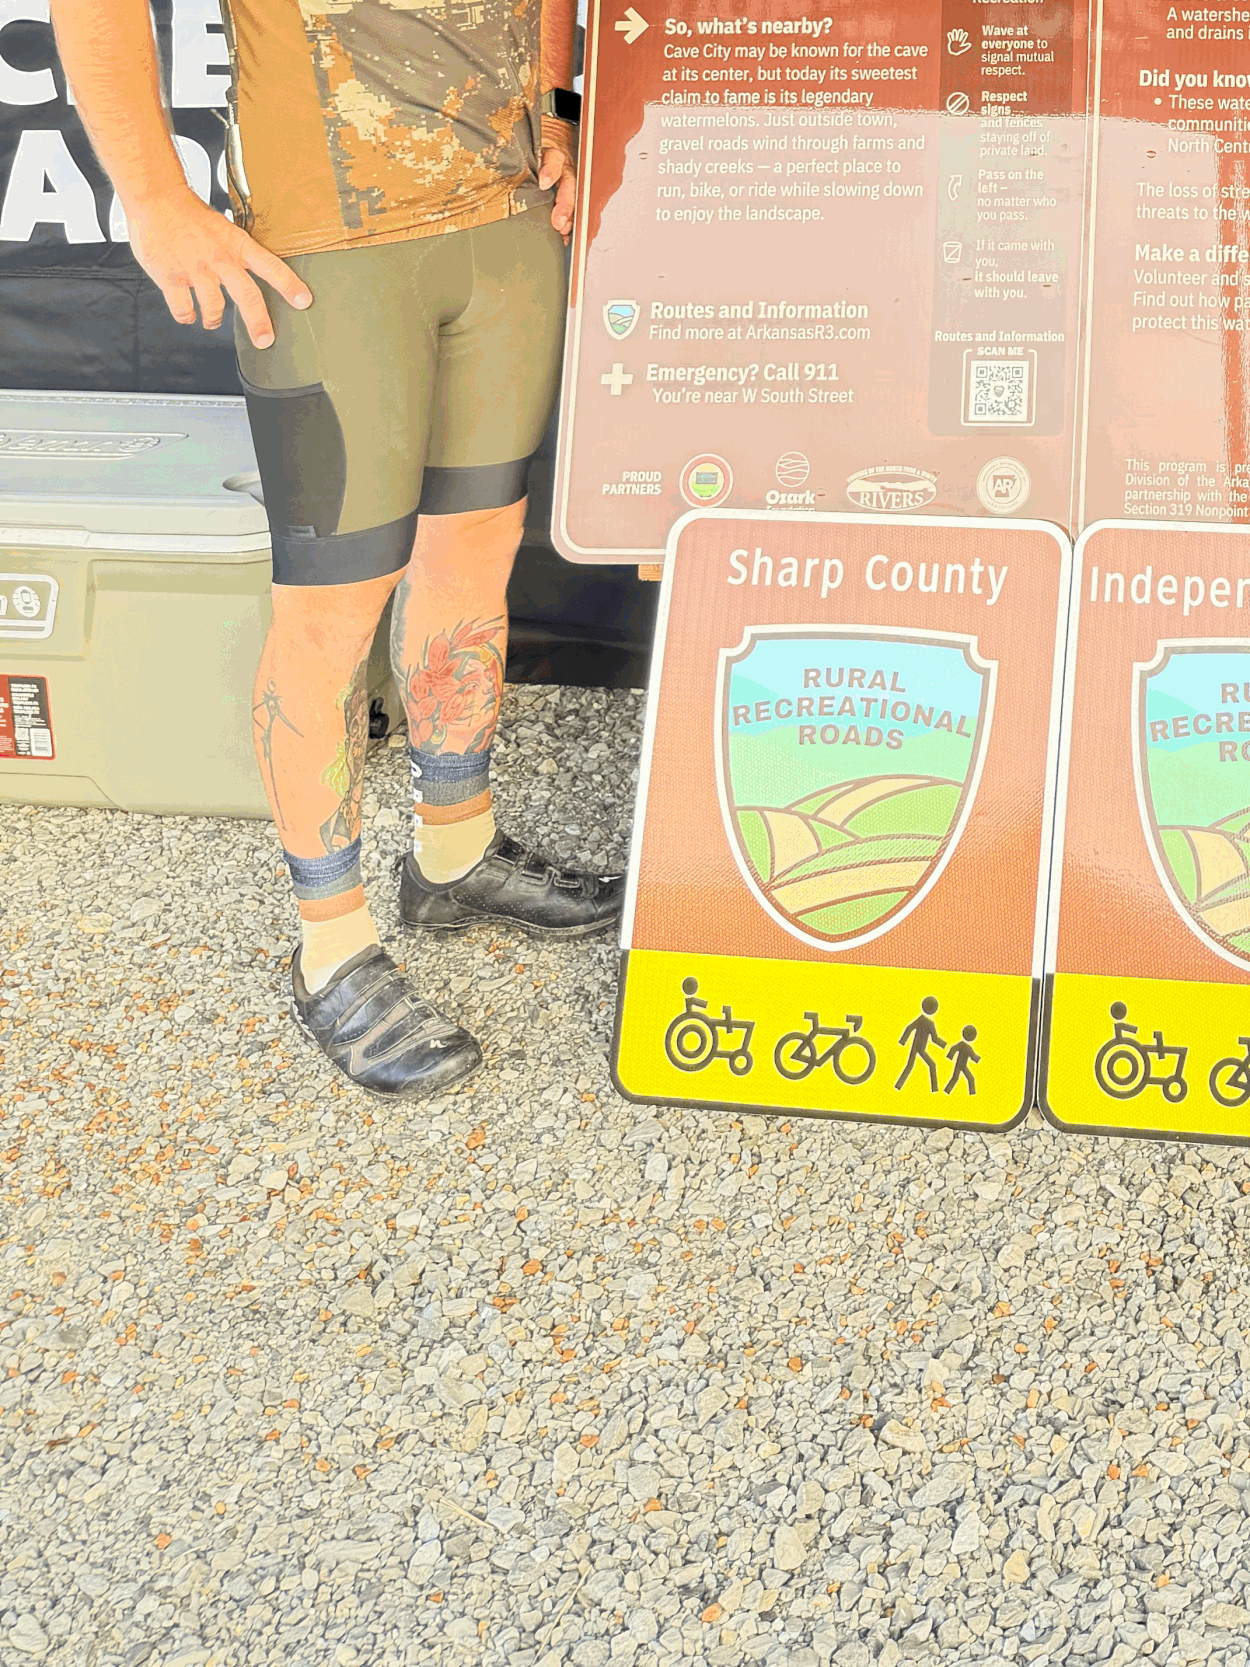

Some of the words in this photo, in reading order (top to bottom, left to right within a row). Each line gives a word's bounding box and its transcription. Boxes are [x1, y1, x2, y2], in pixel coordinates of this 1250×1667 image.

[1166, 6, 1177, 21] A
[664, 17, 692, 37] So,
[761, 16, 832, 38] nearby?
[981, 25, 1014, 36] Wave
[1016, 25, 1028, 35] at
[1166, 24, 1193, 39] and
[1197, 24, 1243, 40] drains
[663, 43, 699, 58] Cave
[702, 42, 731, 61] City
[734, 46, 766, 61] may
[768, 42, 787, 58] be
[791, 42, 838, 57] known
[842, 41, 864, 57] for
[866, 41, 890, 57] the
[893, 45, 928, 57] cave
[981, 39, 1034, 51] everyone
[1037, 39, 1048, 49] to
[981, 52, 1013, 64] signal
[1017, 51, 1054, 62] mutual
[662, 67, 677, 81] at
[680, 66, 699, 81] its
[701, 67, 753, 82] center,
[757, 65, 782, 80] but
[784, 65, 826, 84] today
[829, 65, 847, 80] its
[851, 66, 917, 80] sweetest
[981, 66, 1025, 77] respect.
[1139, 68, 1169, 86] Did
[1174, 73, 1207, 91] you
[661, 89, 700, 105] claim
[704, 91, 720, 104] to
[724, 89, 760, 104] fame
[763, 89, 774, 104] is
[778, 89, 797, 104] its
[801, 89, 873, 108] legendary
[981, 91, 1027, 104] Respect
[1168, 93, 1214, 109] These
[981, 104, 1011, 117] signs
[658, 135, 703, 154] gravel
[707, 134, 748, 150] roads
[752, 134, 787, 150] wind
[791, 134, 848, 153] through
[852, 134, 894, 149] farms
[897, 134, 924, 149] and
[1135, 243, 1184, 261] Make
[1188, 248, 1200, 261] a
[650, 301, 714, 318] Routes
[718, 300, 753, 318] and
[757, 300, 868, 318] Information
[649, 323, 681, 339] Find
[685, 327, 724, 339] more
[726, 325, 742, 339] at
[745, 323, 870, 339] ArkansasR3.com
[977, 346, 1004, 356] SCAN
[1008, 346, 1024, 355] ME
[646, 363, 759, 385] Emergency?
[763, 362, 799, 381] Call
[803, 363, 838, 380] 911
[704, 391, 738, 403] near
[741, 387, 757, 403] W
[760, 387, 803, 403] South
[807, 387, 853, 402] Street
[622, 471, 661, 482] PROUD
[601, 483, 661, 494] PARTNERS
[766, 489, 815, 505] Ozark
[859, 491, 924, 509] RIVERS
[727, 548, 841, 598] Sharp
[864, 552, 1008, 608] County
[802, 667, 907, 693] RURAL
[733, 695, 972, 740] RECREATIONAL
[797, 722, 905, 751] ROADS
